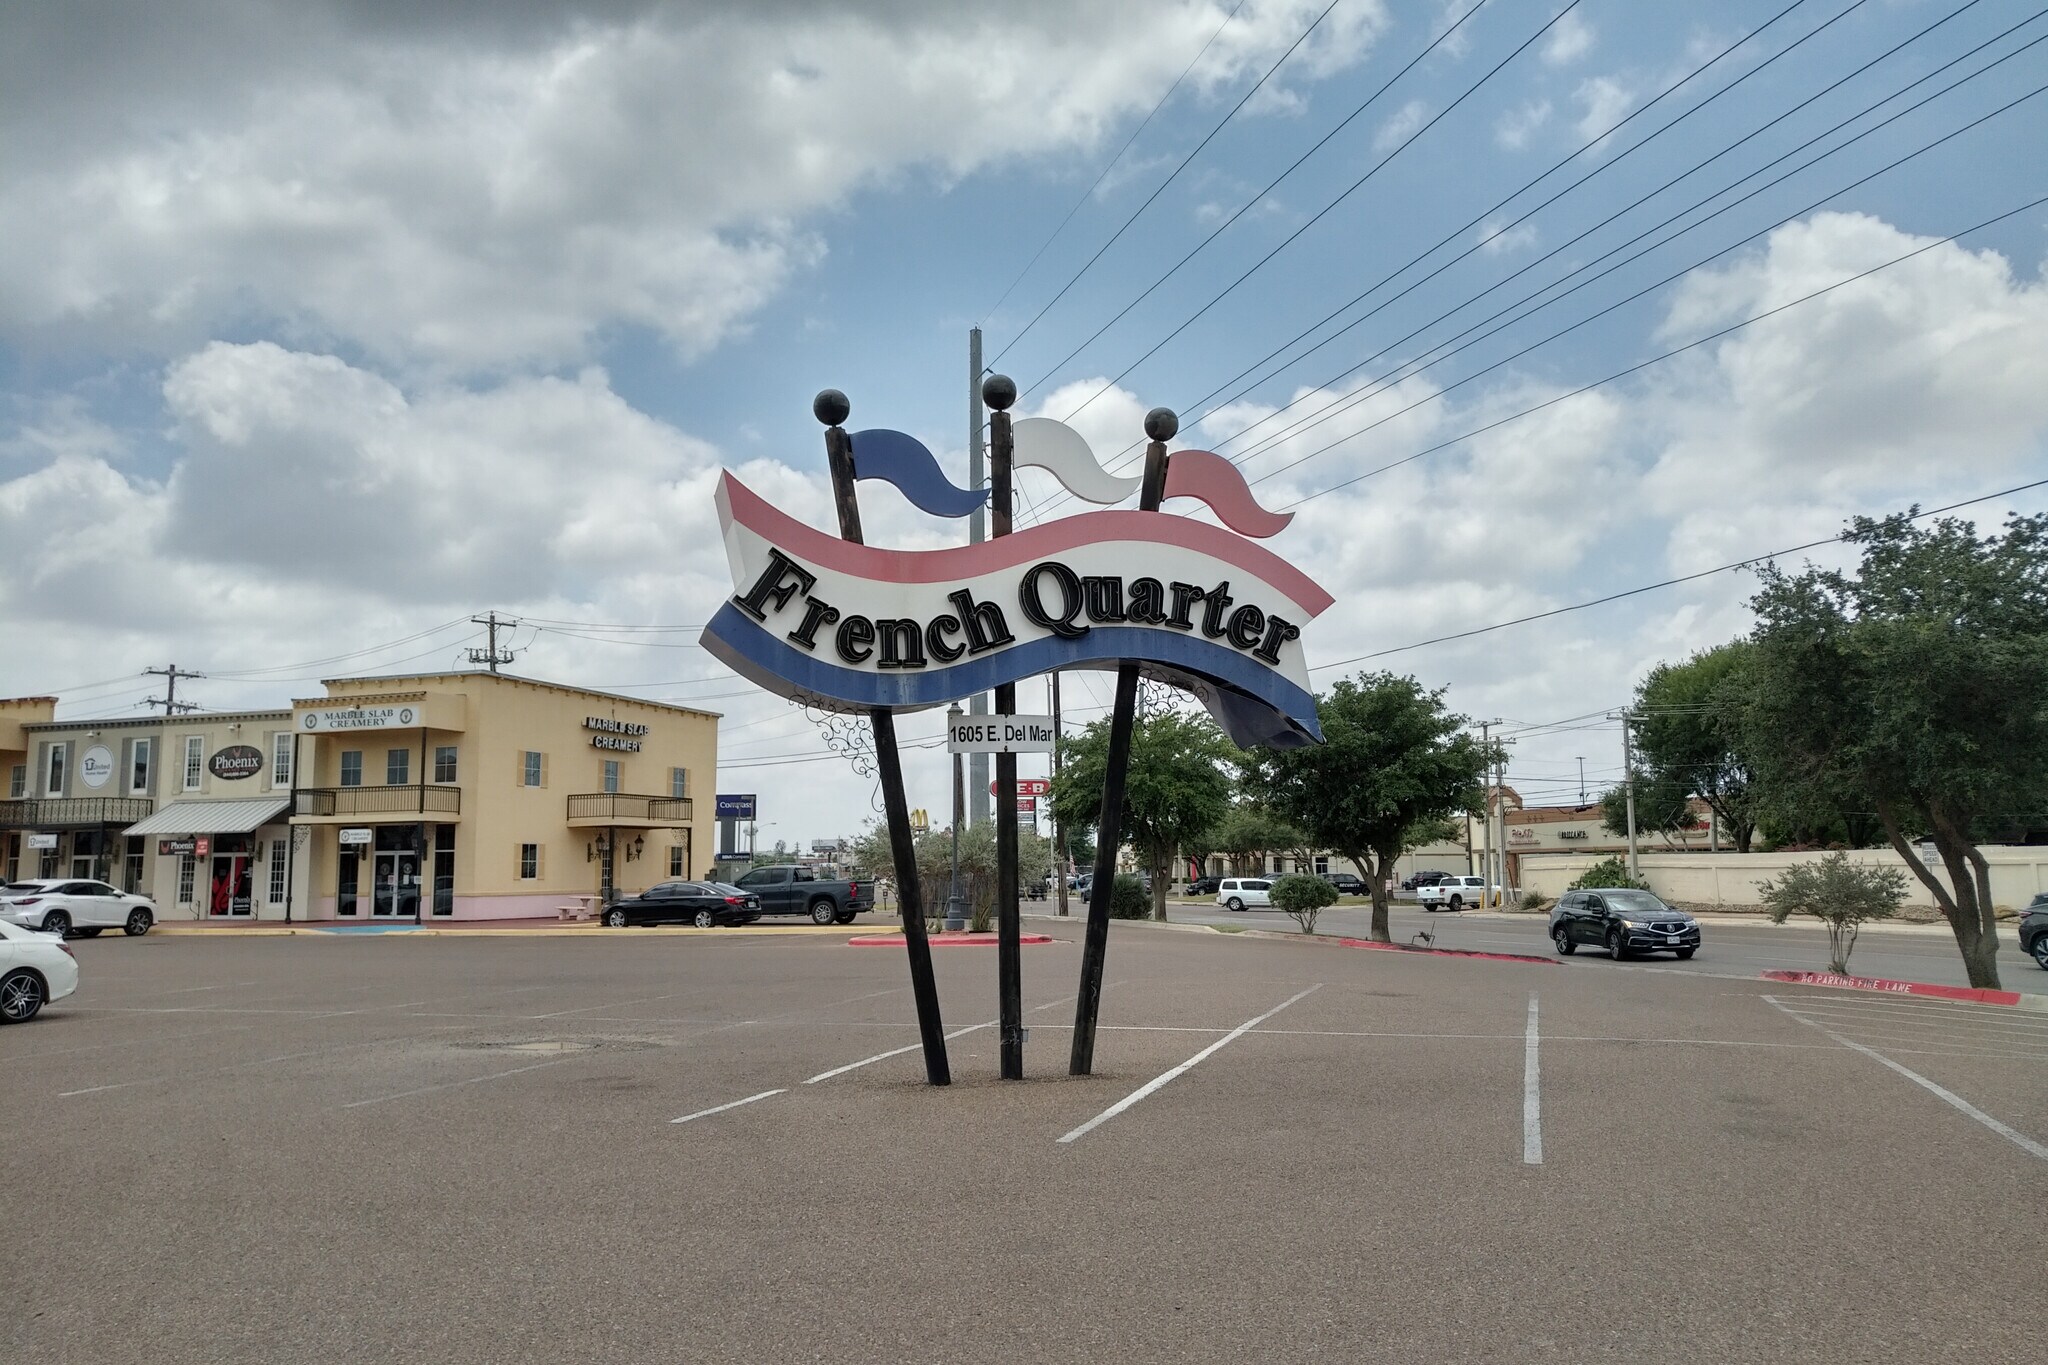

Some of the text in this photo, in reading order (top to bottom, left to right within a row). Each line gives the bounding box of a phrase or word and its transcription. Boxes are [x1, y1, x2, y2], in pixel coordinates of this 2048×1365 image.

[733, 546, 1301, 668] French Quarter
[324, 708, 394, 721] MARBLE SLAB
[329, 717, 387, 729] CREAMERY
[586, 717, 650, 736] MARBLE SLAB
[950, 724, 1053, 743] 1605 E. Del Mar
[593, 735, 643, 752] CREAMERY
[214, 754, 259, 770] Phoenix
[170, 841, 195, 850] Phoenix
[1801, 974, 1913, 993] NO PARKING FIRE LANE
